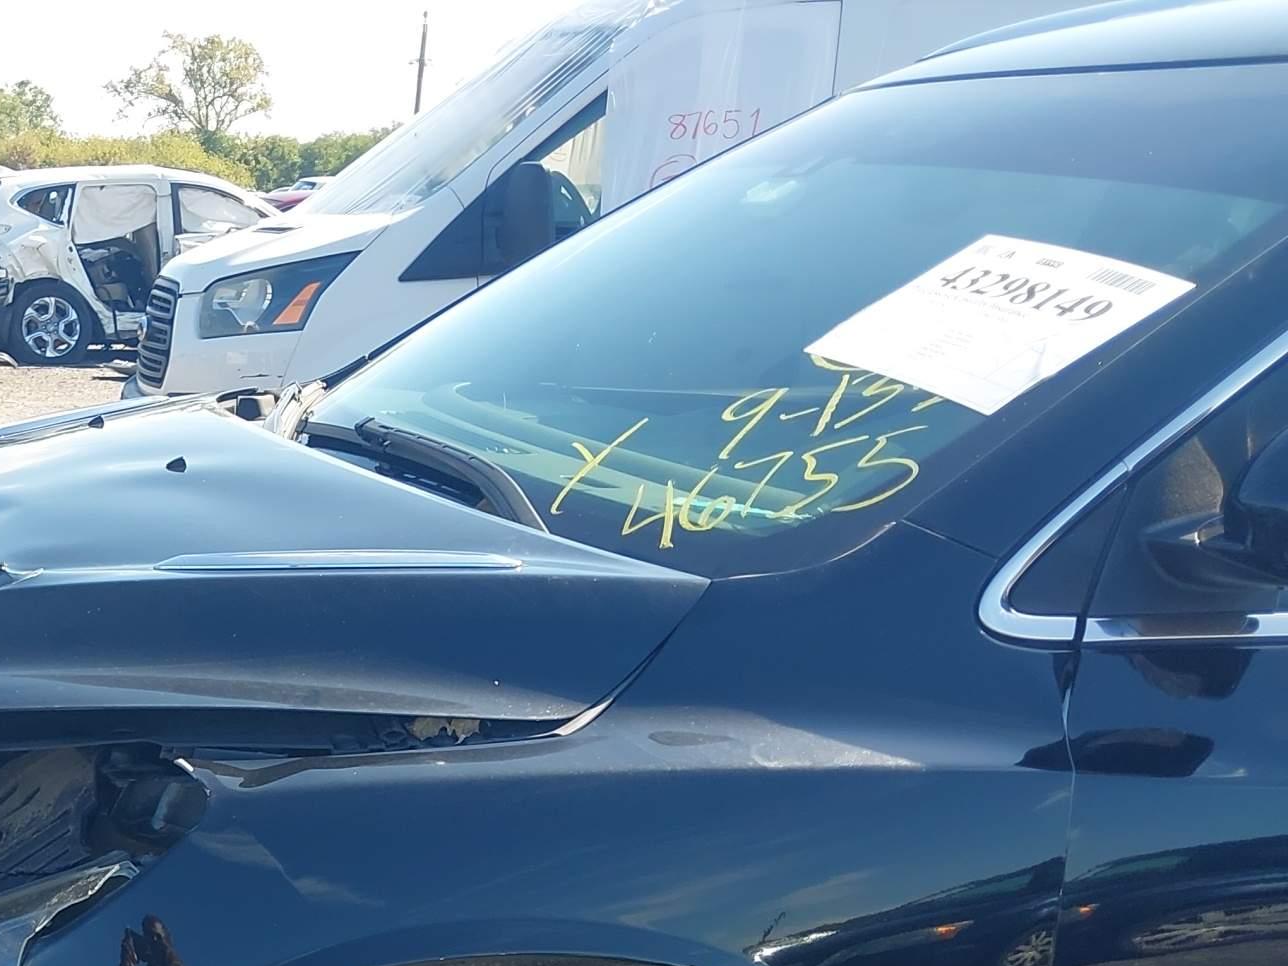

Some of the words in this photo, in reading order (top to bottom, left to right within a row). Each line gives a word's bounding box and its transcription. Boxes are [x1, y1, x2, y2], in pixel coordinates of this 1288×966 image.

[667, 107, 761, 140] 87651
[939, 265, 1114, 321] 43298149
[621, 425, 928, 549] 46755
